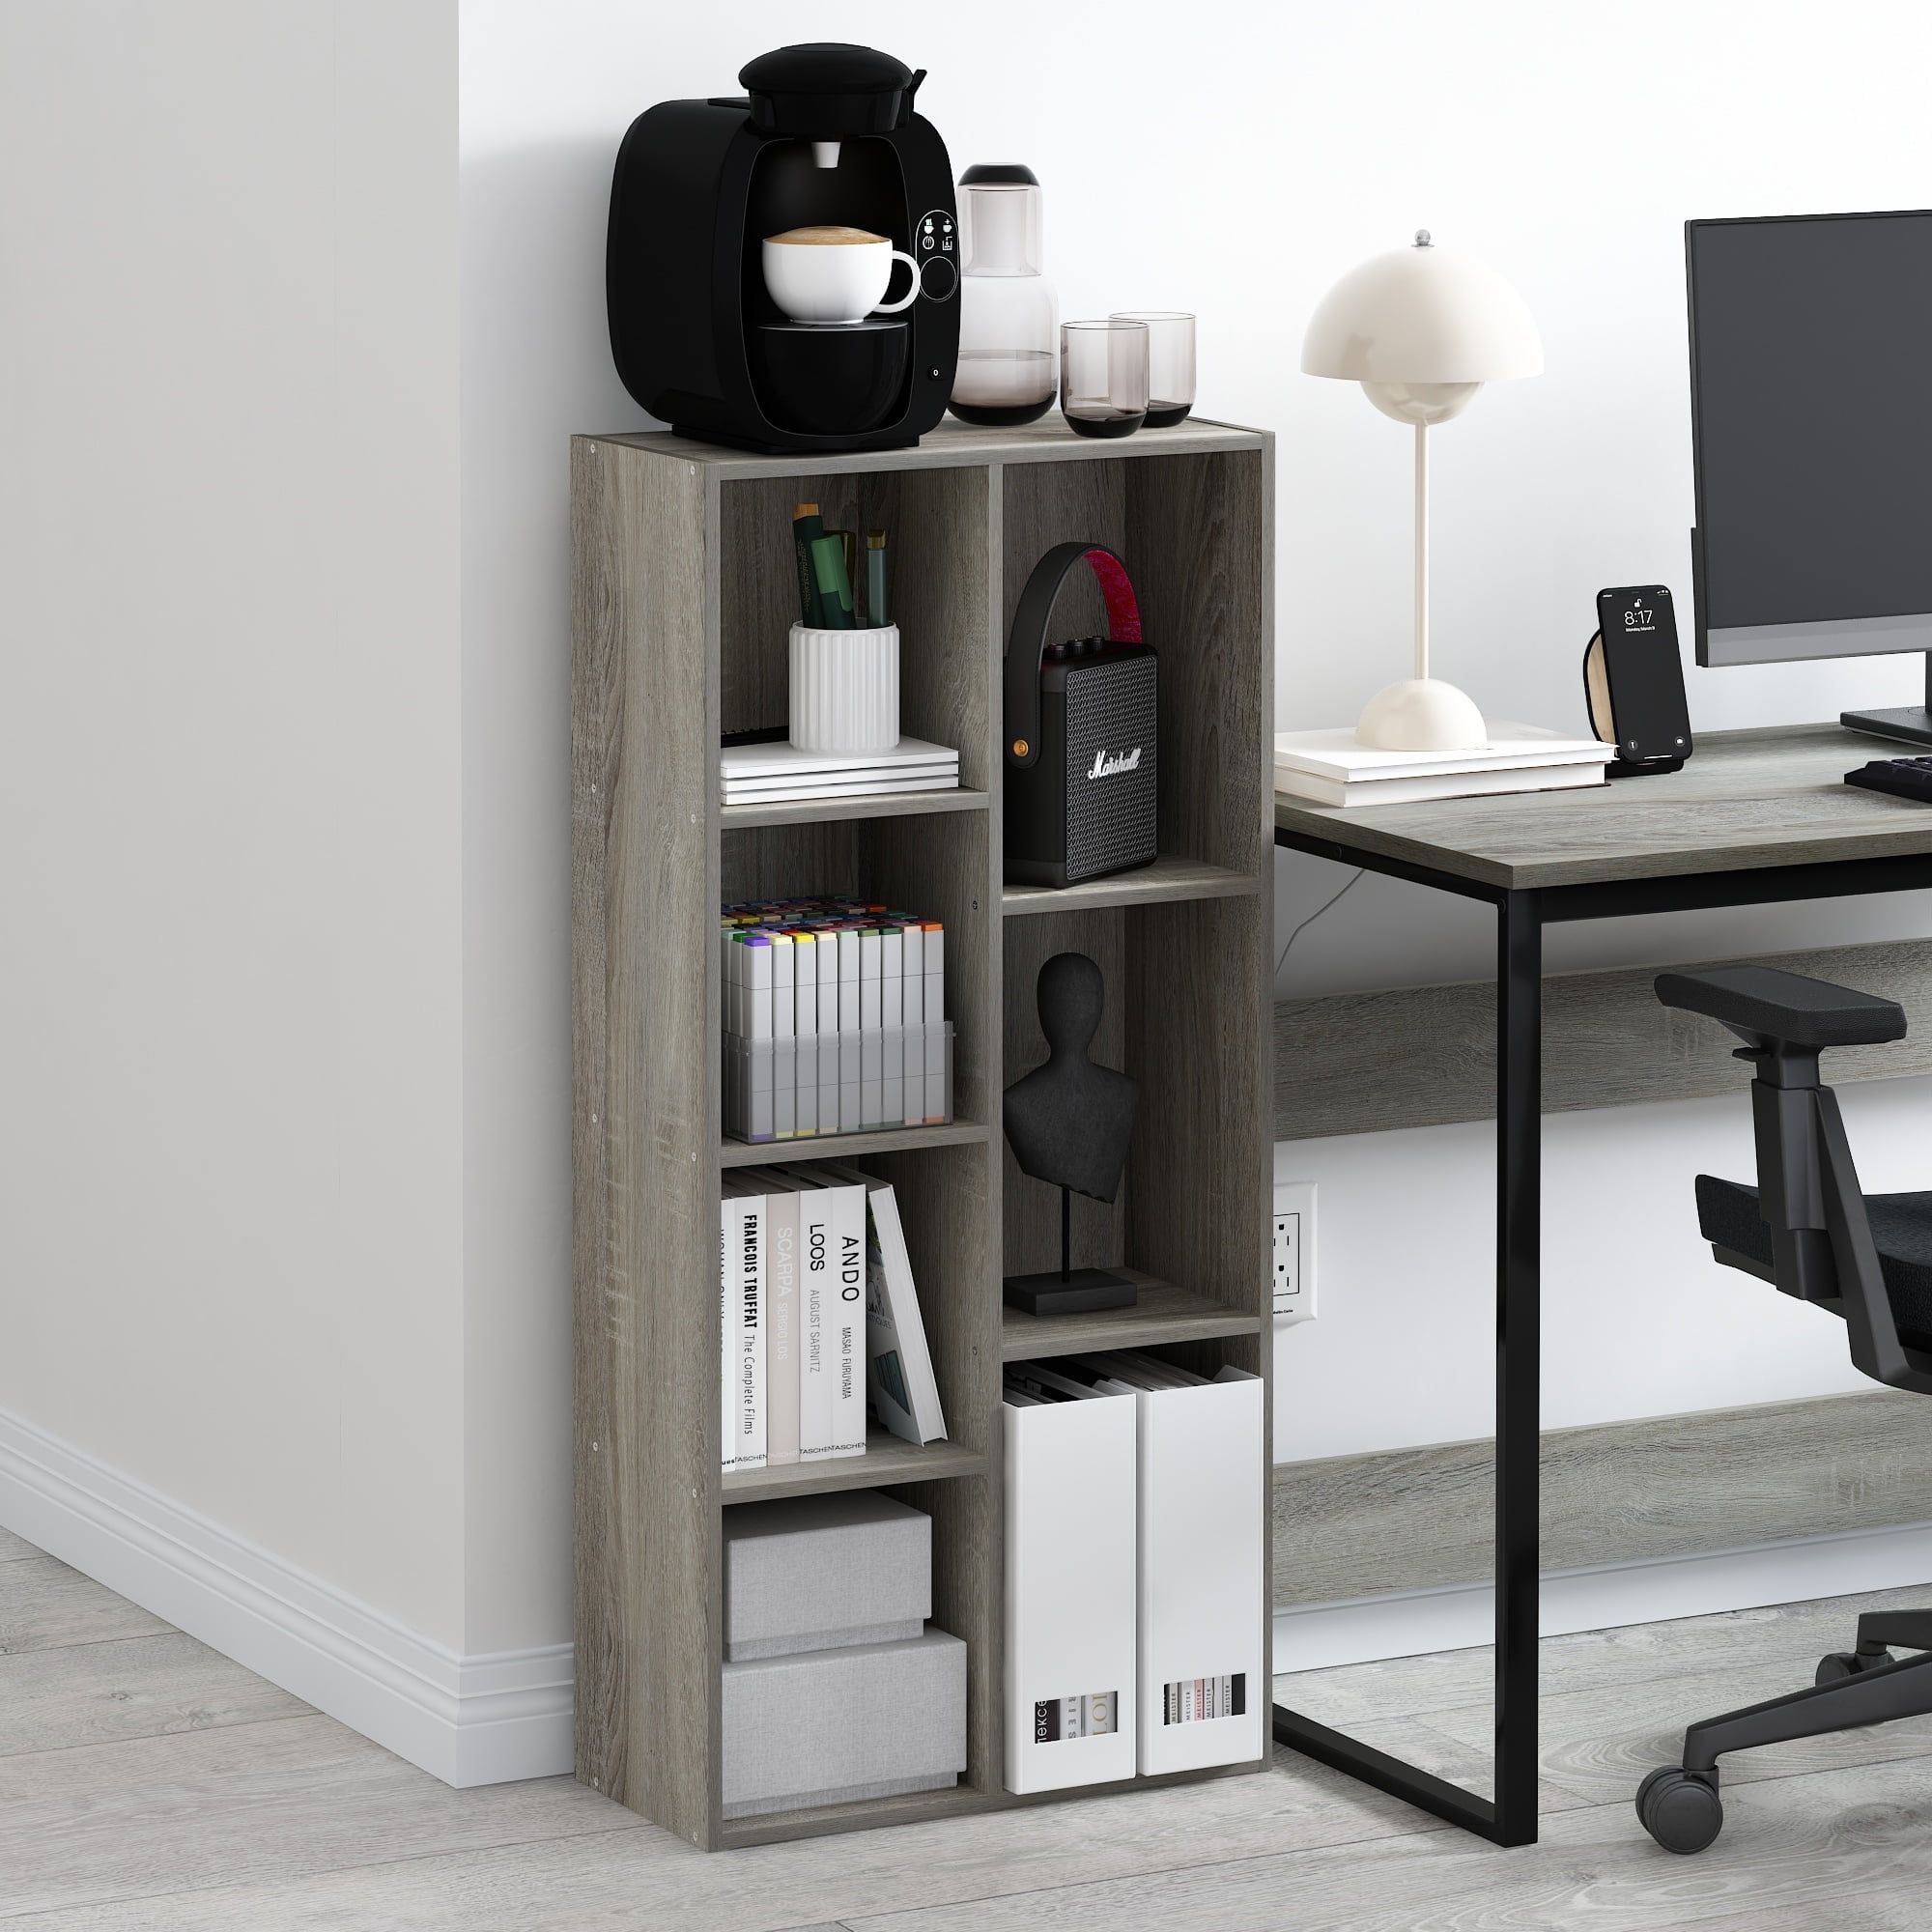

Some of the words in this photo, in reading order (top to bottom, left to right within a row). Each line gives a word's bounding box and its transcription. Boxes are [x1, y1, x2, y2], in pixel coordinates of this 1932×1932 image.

[1624, 610, 1653, 626] 8:17
[1088, 748, 1141, 780] Marshall
[744, 1214, 757, 1273] FRANCOIS
[777, 1227, 793, 1297] SCARPA
[810, 1224, 825, 1271] LOOS
[841, 1236, 860, 1302] ANDO
[744, 1277, 757, 1328] TRUFFAT
[810, 1290, 820, 1328] AUGUST
[744, 1334, 755, 1353] The
[777, 1341, 788, 1360] LOS
[810, 1331, 820, 1374] SARNITZ
[841, 1326, 852, 1354] MASAO
[742, 1356, 755, 1405] Complete
[841, 1358, 852, 1400] FURUYAMA
[744, 1408, 755, 1435] Films
